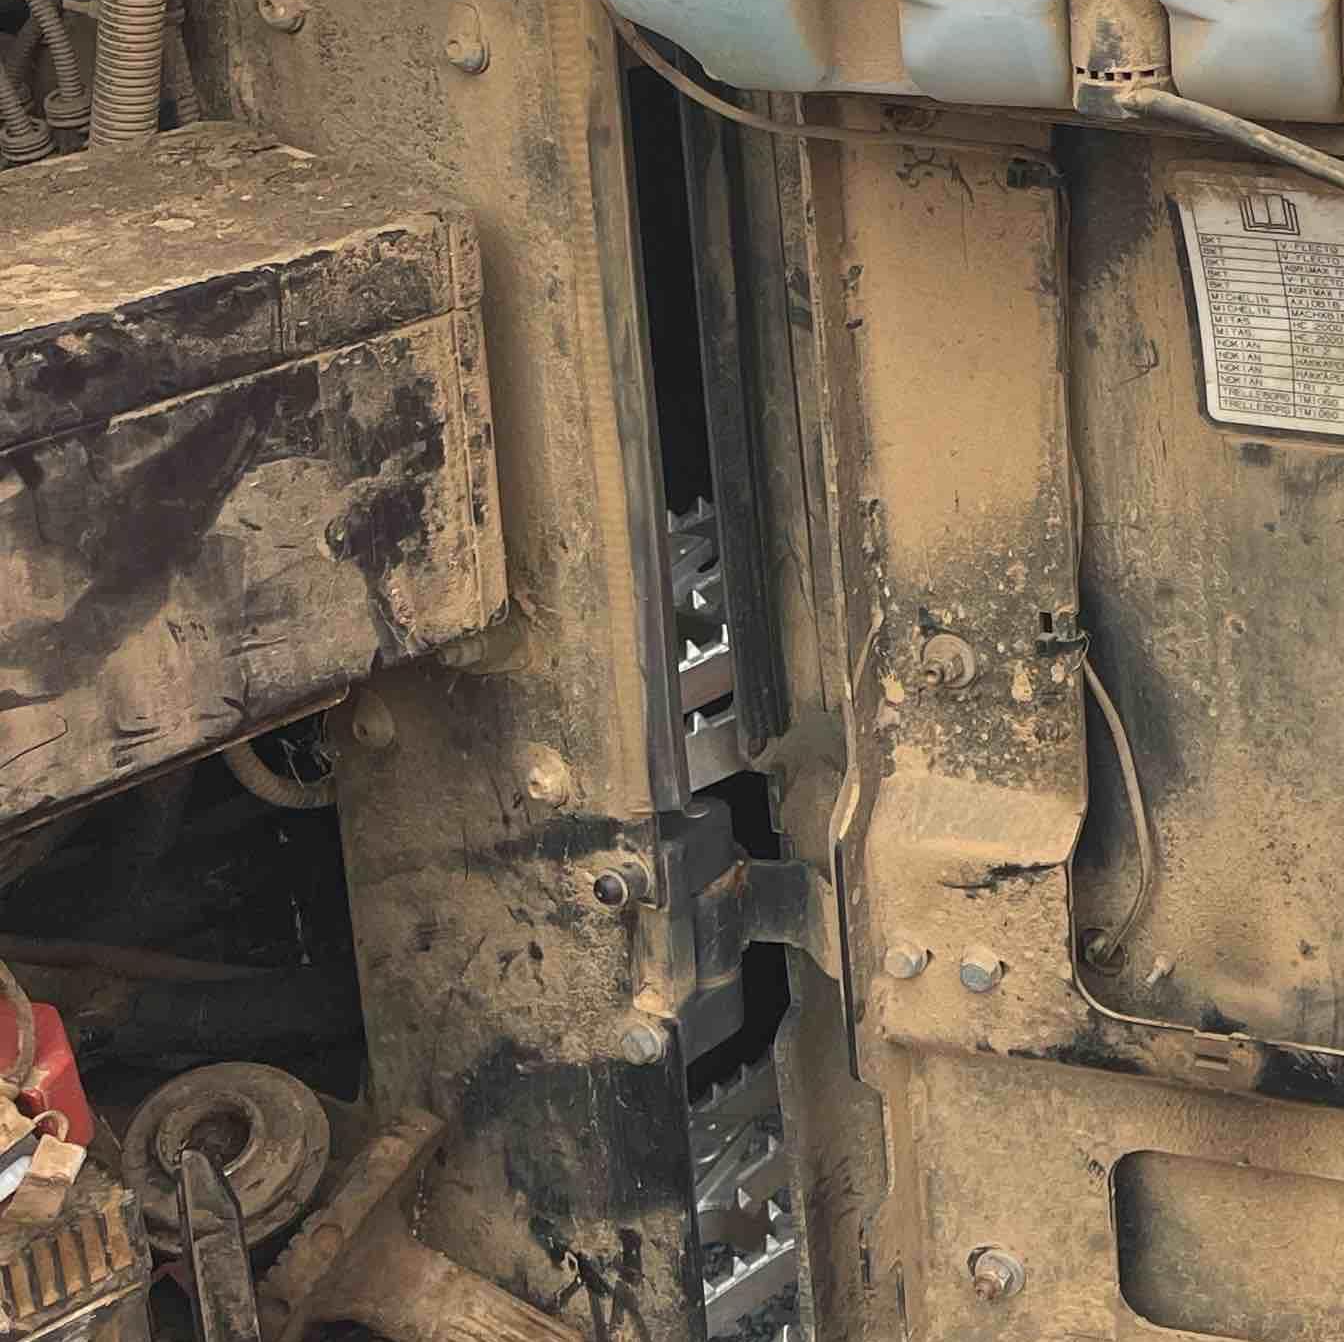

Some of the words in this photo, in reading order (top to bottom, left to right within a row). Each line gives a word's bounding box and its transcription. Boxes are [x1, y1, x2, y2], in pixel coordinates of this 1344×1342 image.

[1210, 292, 1268, 303] MICHELIN
[1212, 303, 1270, 315] MICHELIN
[1217, 338, 1260, 349] NOKIAN
[1218, 350, 1261, 362] NOKIAN
[1219, 362, 1261, 374] NOKIAN
[1220, 374, 1263, 386] NOKIAN
